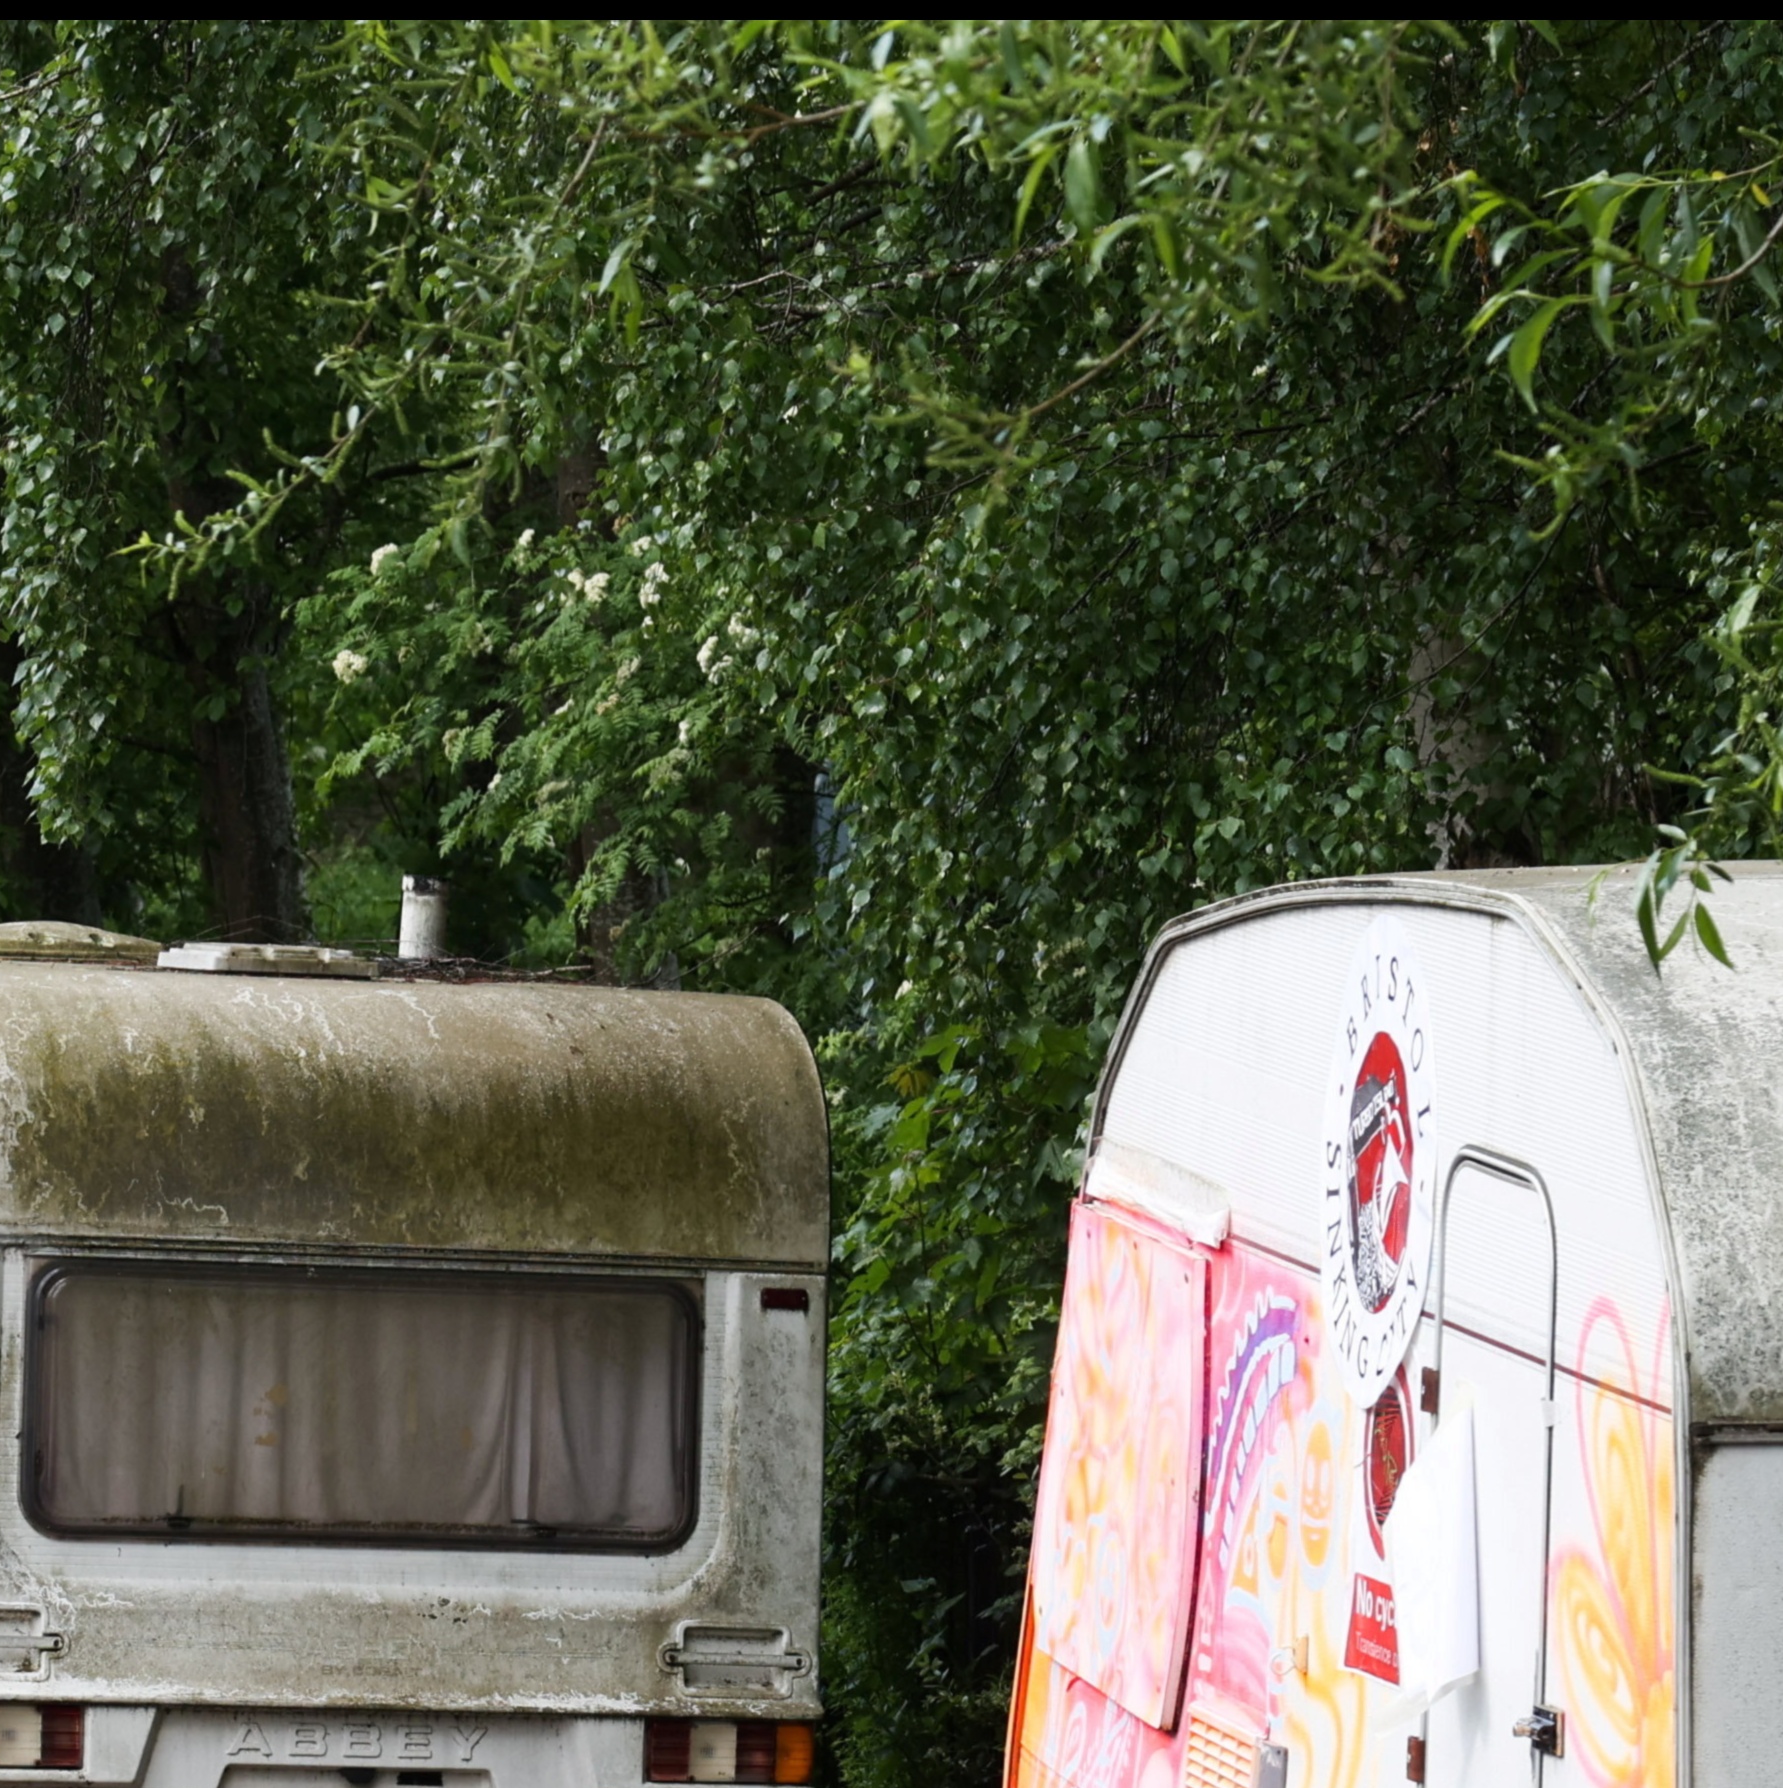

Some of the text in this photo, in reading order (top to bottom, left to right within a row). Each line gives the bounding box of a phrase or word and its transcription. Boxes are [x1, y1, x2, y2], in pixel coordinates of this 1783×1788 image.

[1346, 954, 1431, 1138] BRISTOL
[1326, 1141, 1418, 1379] SINKING CITY
[1355, 1577, 1396, 1632] No cyc
[226, 1722, 490, 1762] ABBEY
